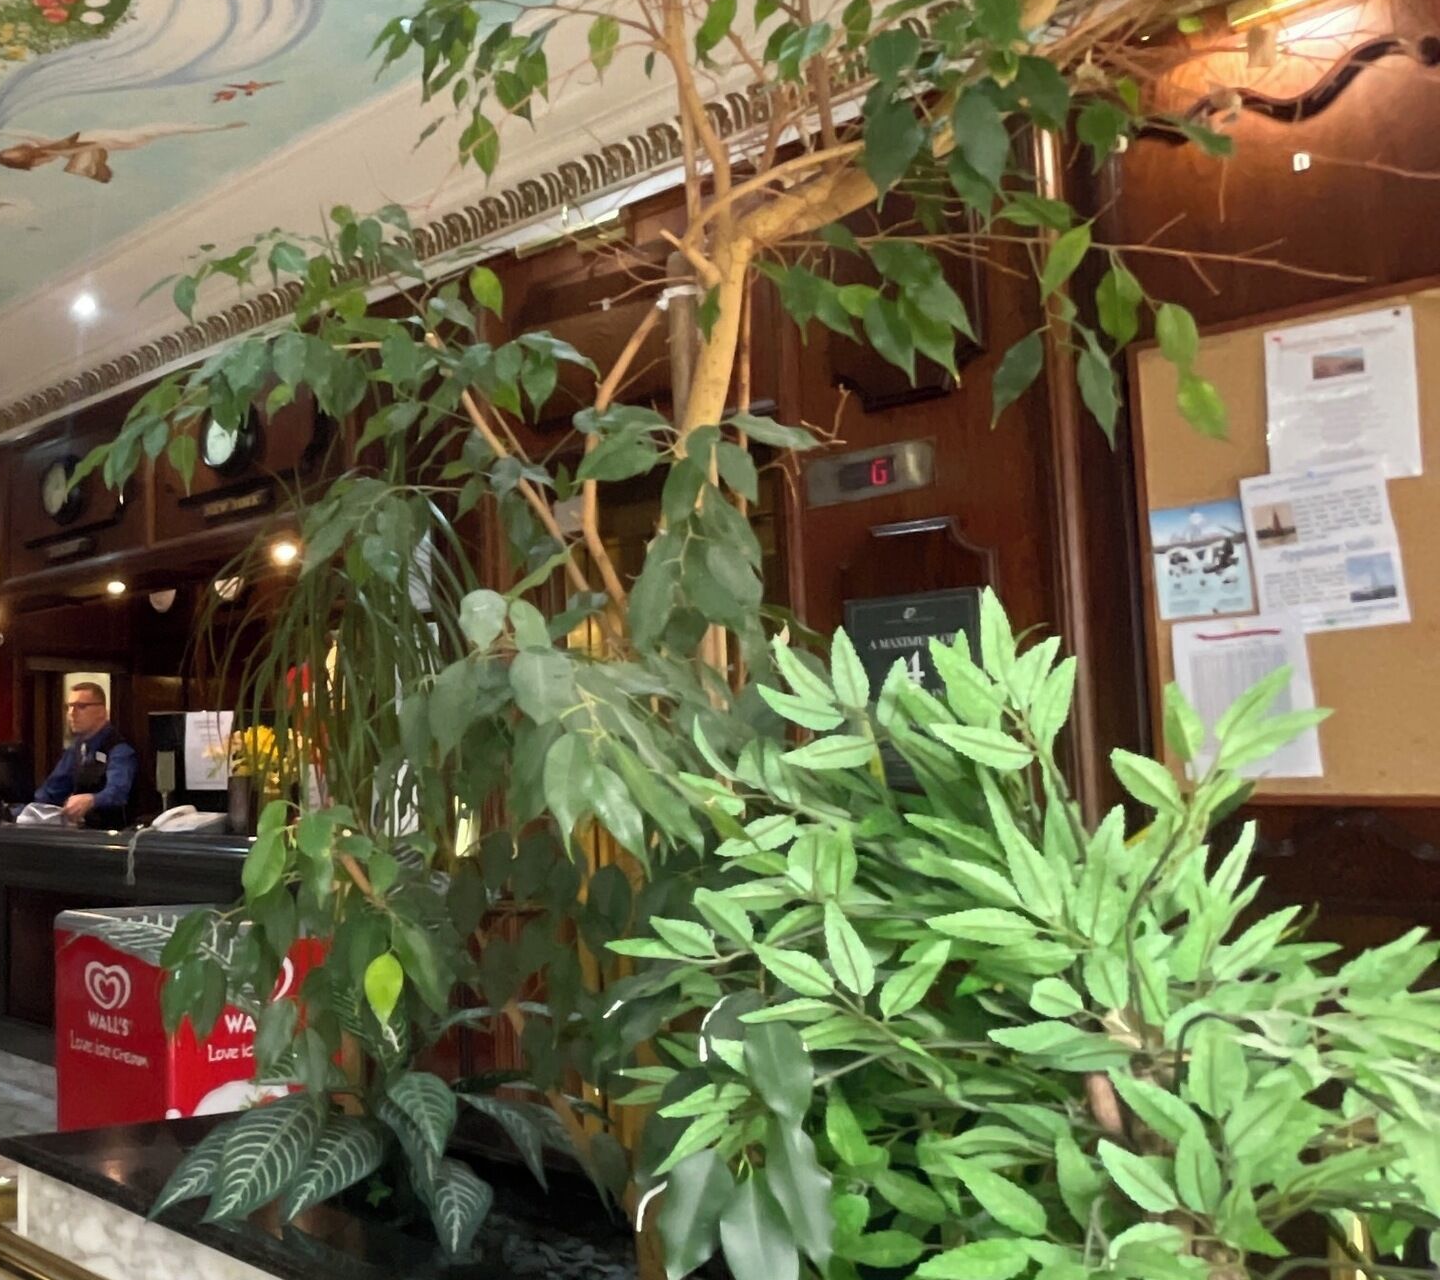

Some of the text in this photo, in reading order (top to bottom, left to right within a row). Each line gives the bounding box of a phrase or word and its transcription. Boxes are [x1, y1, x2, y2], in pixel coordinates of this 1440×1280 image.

[871, 458, 889, 486] G
[878, 634, 937, 650] MAXIMU
[905, 650, 926, 686] 4
[87, 1009, 130, 1037] WALL'S
